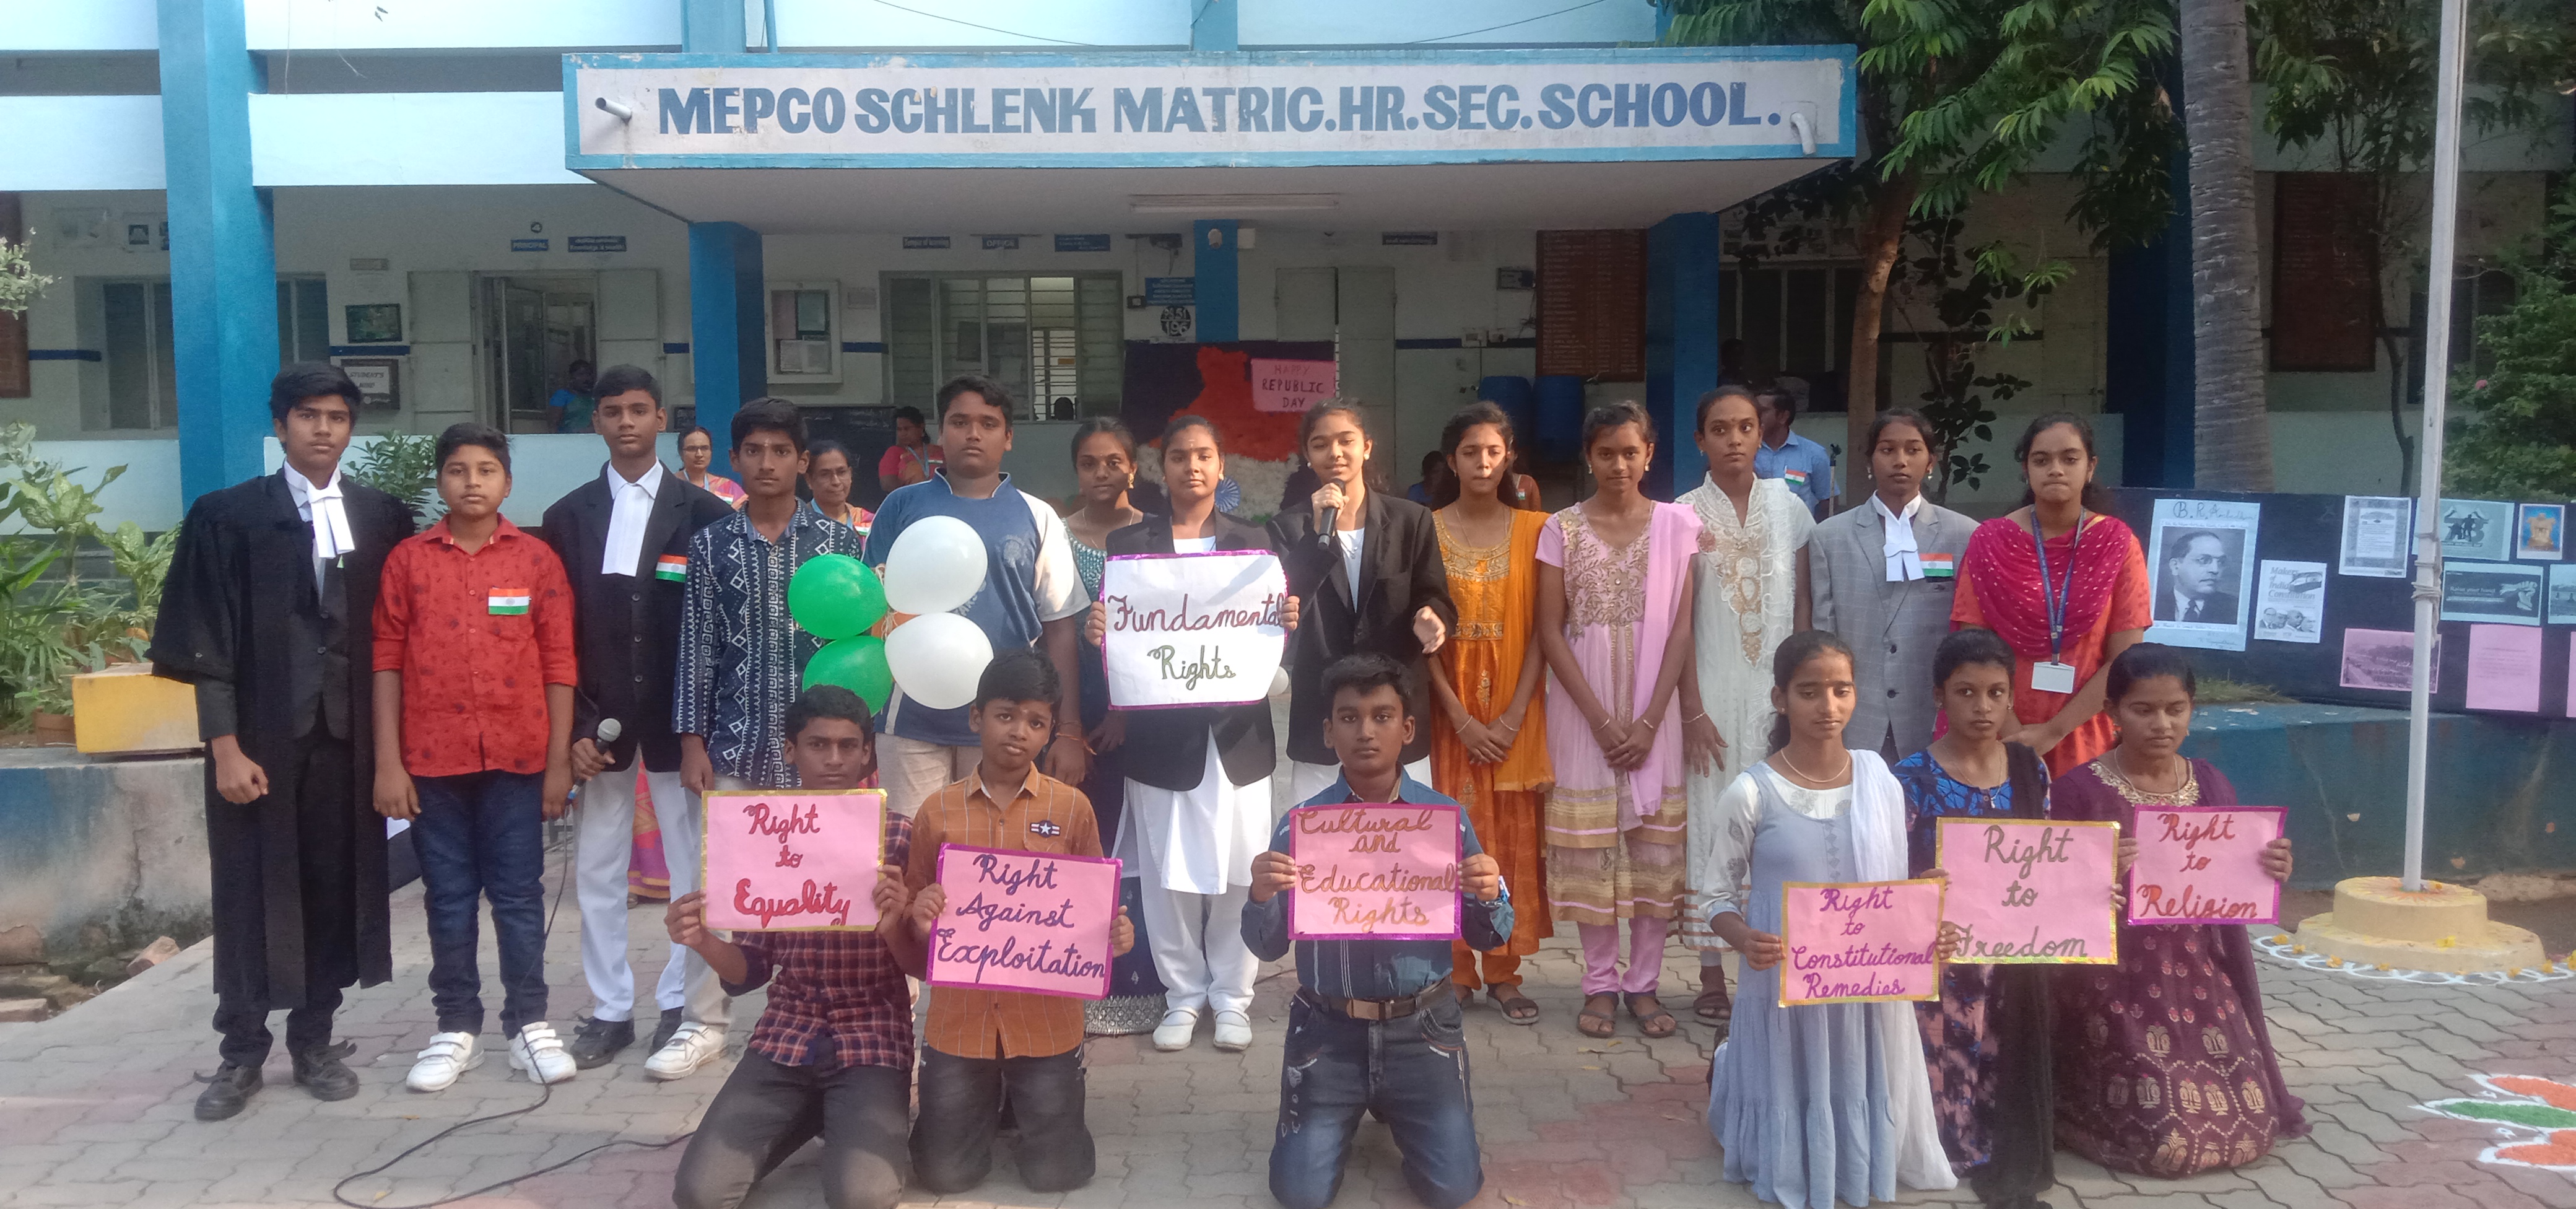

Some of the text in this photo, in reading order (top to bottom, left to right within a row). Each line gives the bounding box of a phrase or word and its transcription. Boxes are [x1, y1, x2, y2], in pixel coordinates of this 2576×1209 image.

[658, 87, 846, 134] MEPCO
[854, 86, 1096, 133] SCHLENK
[1262, 378, 1325, 394] REPUBLIC
[1274, 364, 1310, 376] HAPPY
[1282, 397, 1305, 408] DAY
[2269, 566, 2299, 575] Makers
[2268, 589, 2316, 600] Constitution
[1107, 593, 1284, 632] Fundamental
[1147, 645, 1236, 691] Rights
[742, 803, 820, 844] Right
[1298, 808, 1434, 834] Cultural
[2157, 813, 2235, 850] Right
[775, 845, 803, 868] to
[1349, 832, 1401, 853] and
[1983, 824, 2074, 879] Right
[973, 853, 1058, 896] Right
[1296, 862, 1456, 893] Educational
[2179, 851, 2211, 872] to
[734, 878, 850, 928] Equality
[1819, 886, 1894, 919] Right
[2001, 880, 2038, 907] to
[2136, 884, 2258, 919] Religion
[955, 891, 1074, 932] Against
[1328, 896, 1430, 933] Rights
[1840, 919, 1865, 936] to
[936, 928, 1105, 984] Exploitation
[1791, 941, 1936, 971] Constitutional
[1955, 923, 2088, 957] Freedom
[1803, 971, 1906, 1000] Remedies
